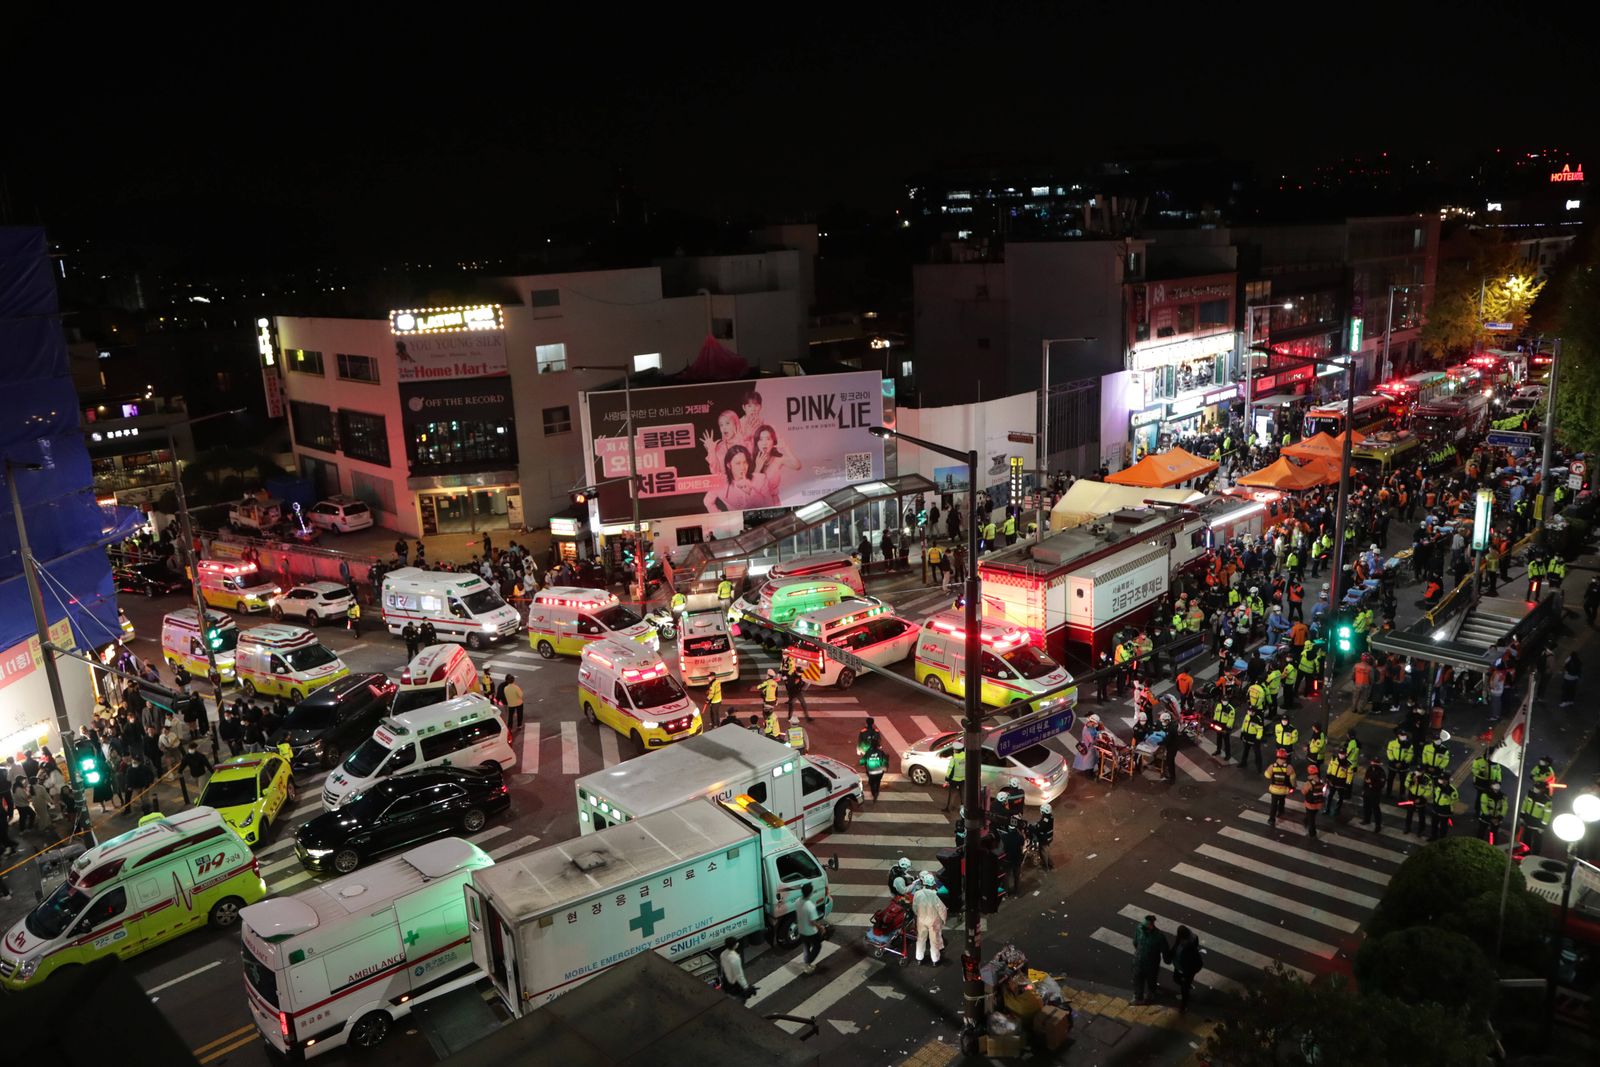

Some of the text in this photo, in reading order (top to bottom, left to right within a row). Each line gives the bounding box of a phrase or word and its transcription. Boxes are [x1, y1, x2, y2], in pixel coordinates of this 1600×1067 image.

[436, 337, 472, 351] YOUNG
[476, 335, 502, 347] SILK
[414, 365, 452, 378] Home
[454, 363, 488, 376] Mart
[425, 395, 504, 407] OFF THE RECORD
[840, 391, 871, 402] 핑크라이
[648, 409, 657, 418] 단
[659, 406, 684, 417] 하나의
[685, 404, 711, 415] 거짓말
[786, 394, 836, 423] PINK
[838, 402, 871, 429] LIE
[643, 430, 691, 449] 클럽은
[1112, 578, 1135, 594] 서울특별시
[1112, 576, 1163, 613] 긴급구조통제단
[6, 651, 31, 676] (1층)
[1022, 720, 1050, 737] 이태원로
[1060, 715, 1072, 727] 177
[1000, 739, 1010, 751] 181
[198, 852, 225, 876] 119
[670, 917, 749, 956] SNUH 서울대학교병원
[564, 917, 715, 981] MOBILE EMERGENCY SUPPORT UNIT
[348, 952, 406, 984] AMBULANCE
